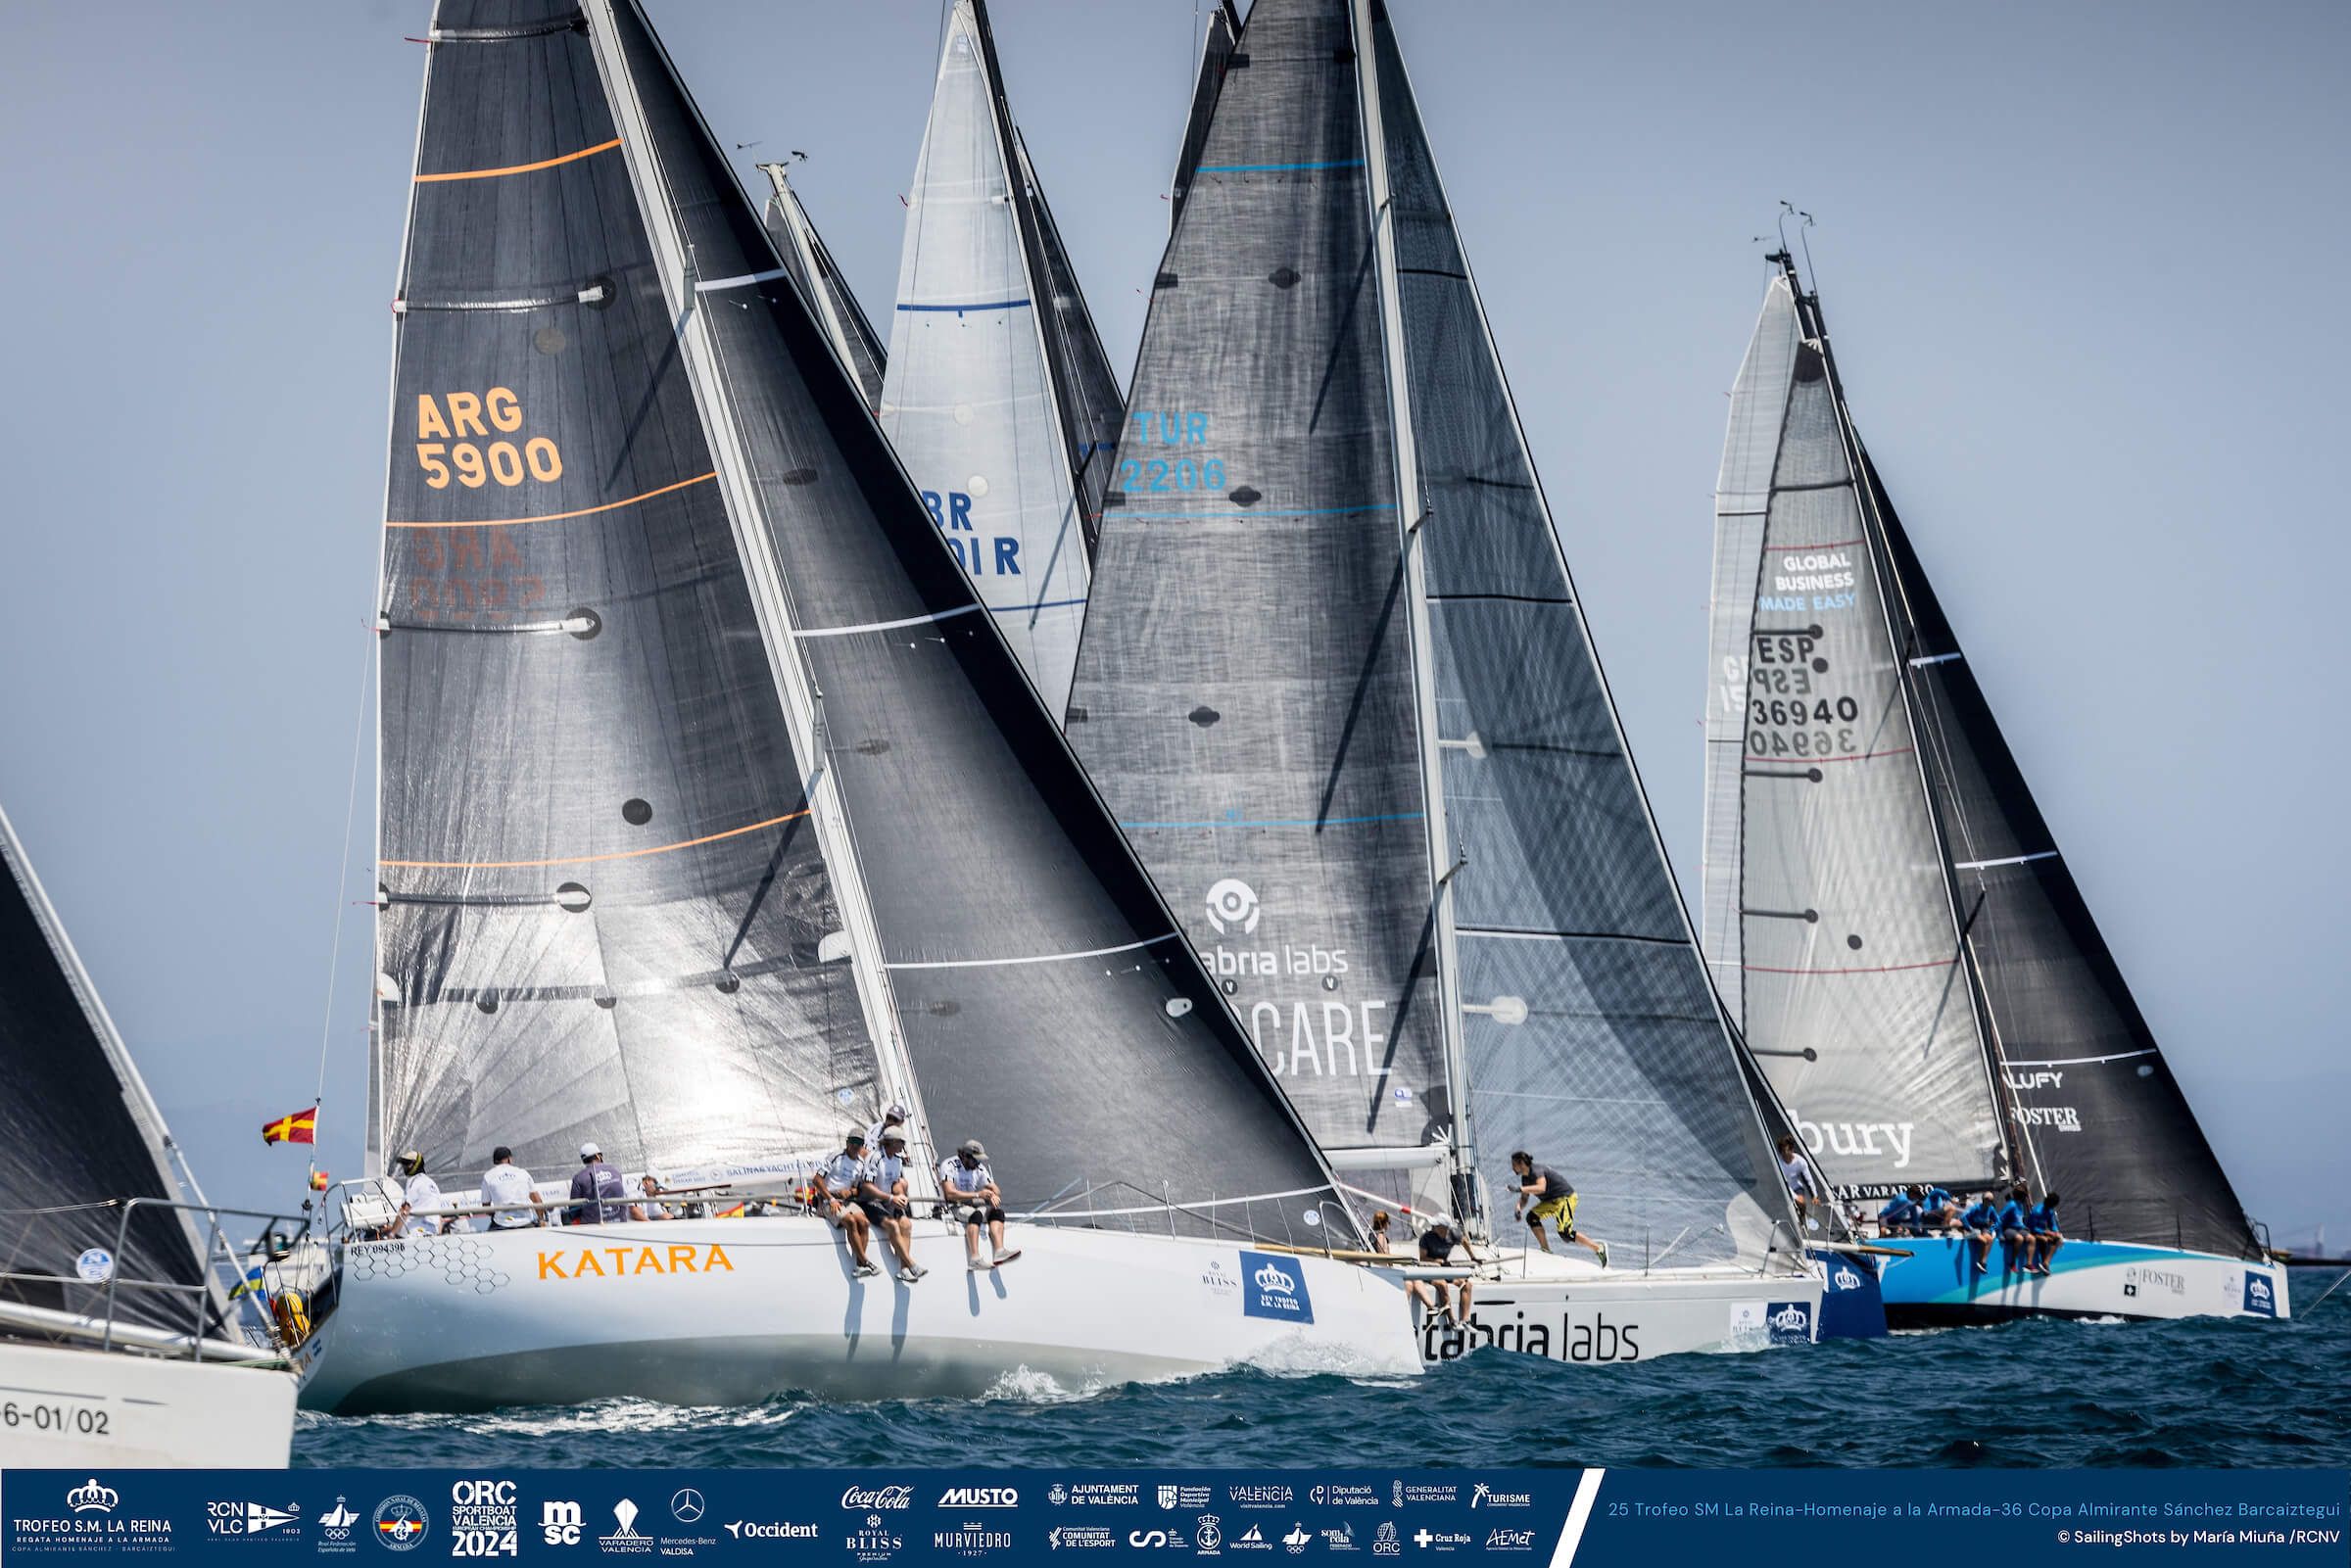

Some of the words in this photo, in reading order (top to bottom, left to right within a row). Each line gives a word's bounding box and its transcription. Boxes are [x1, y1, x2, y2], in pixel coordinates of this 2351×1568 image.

[418, 387, 522, 439] ARG
[1132, 410, 1208, 446] TUR
[416, 437, 563, 489] 5900
[1121, 457, 1226, 493] 2206
[1783, 553, 1851, 572] GLOBAL
[1774, 572, 1854, 592] BUSINESS
[1757, 595, 1807, 611] MADE
[1813, 594, 1856, 611] EASY
[1756, 638, 1814, 663] ESP
[1751, 696, 1858, 726] 36940
[1285, 944, 1349, 975] labs
[1863, 1183, 1935, 1198] VARADRO
[537, 1244, 735, 1280] KATARA
[2142, 1268, 2185, 1290] FOSTER
[1563, 1312, 1639, 1361] labs
